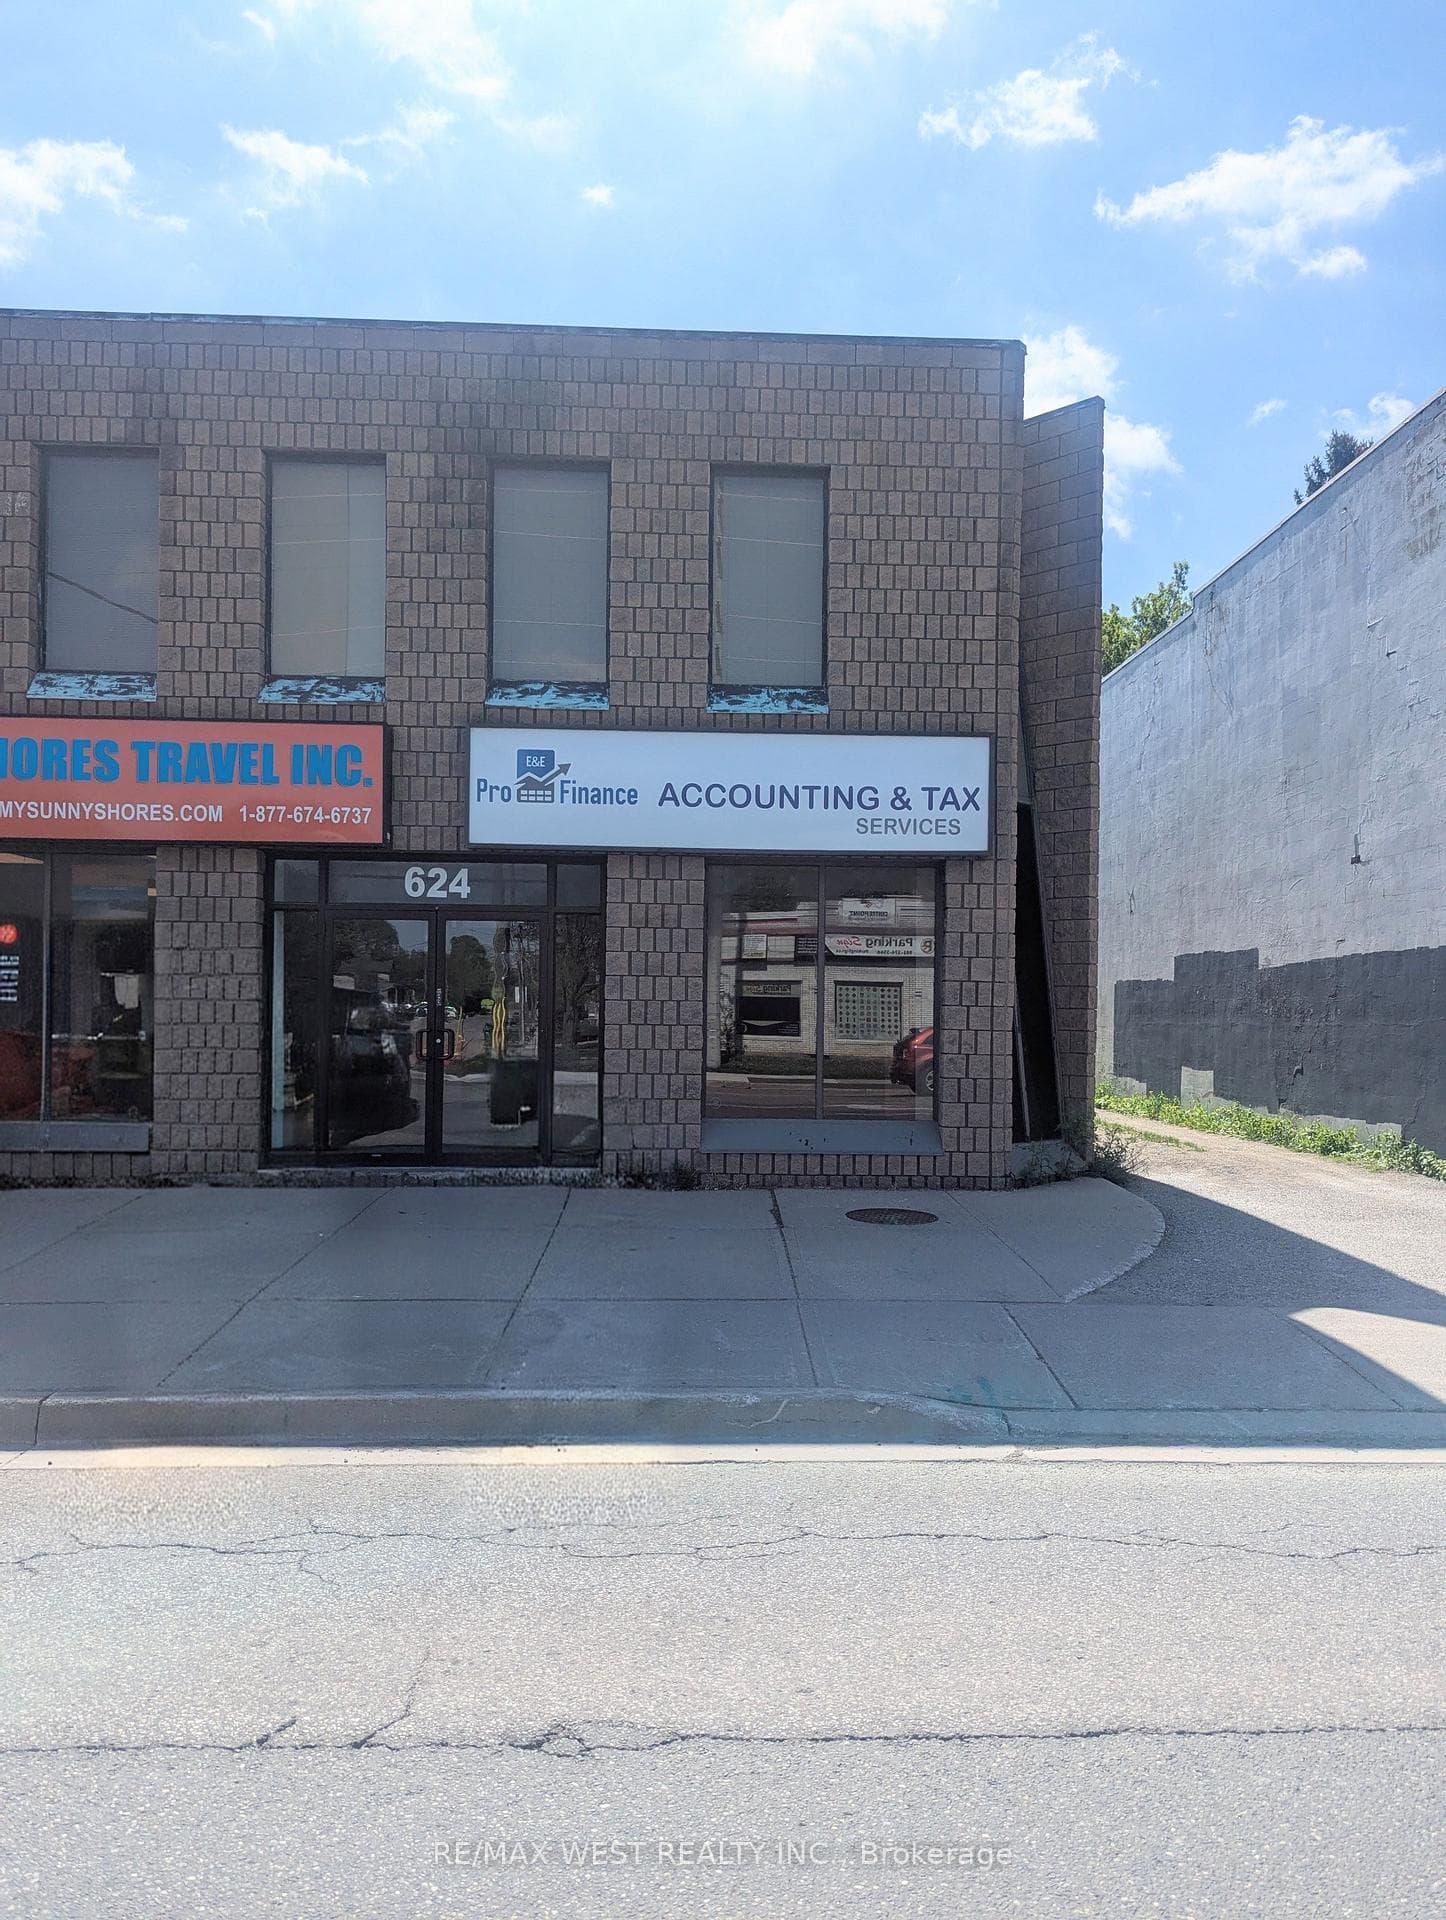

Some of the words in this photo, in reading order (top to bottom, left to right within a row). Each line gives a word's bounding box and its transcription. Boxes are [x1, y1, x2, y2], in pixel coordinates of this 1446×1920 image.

[131, 740, 280, 785] TRAVEL
[290, 743, 374, 787] INC.
[526, 755, 546, 768] E&E
[476, 778, 512, 803] Pro
[560, 779, 639, 806] Finance
[657, 782, 880, 811] ACCOUNTING
[889, 785, 913, 812] &
[920, 786, 981, 812] TAX
[0, 801, 223, 823] MYSUNNYSHORES.COM
[239, 805, 373, 825] 1-877-674-6737
[855, 818, 961, 836] SERVICES
[404, 866, 471, 899] 624
